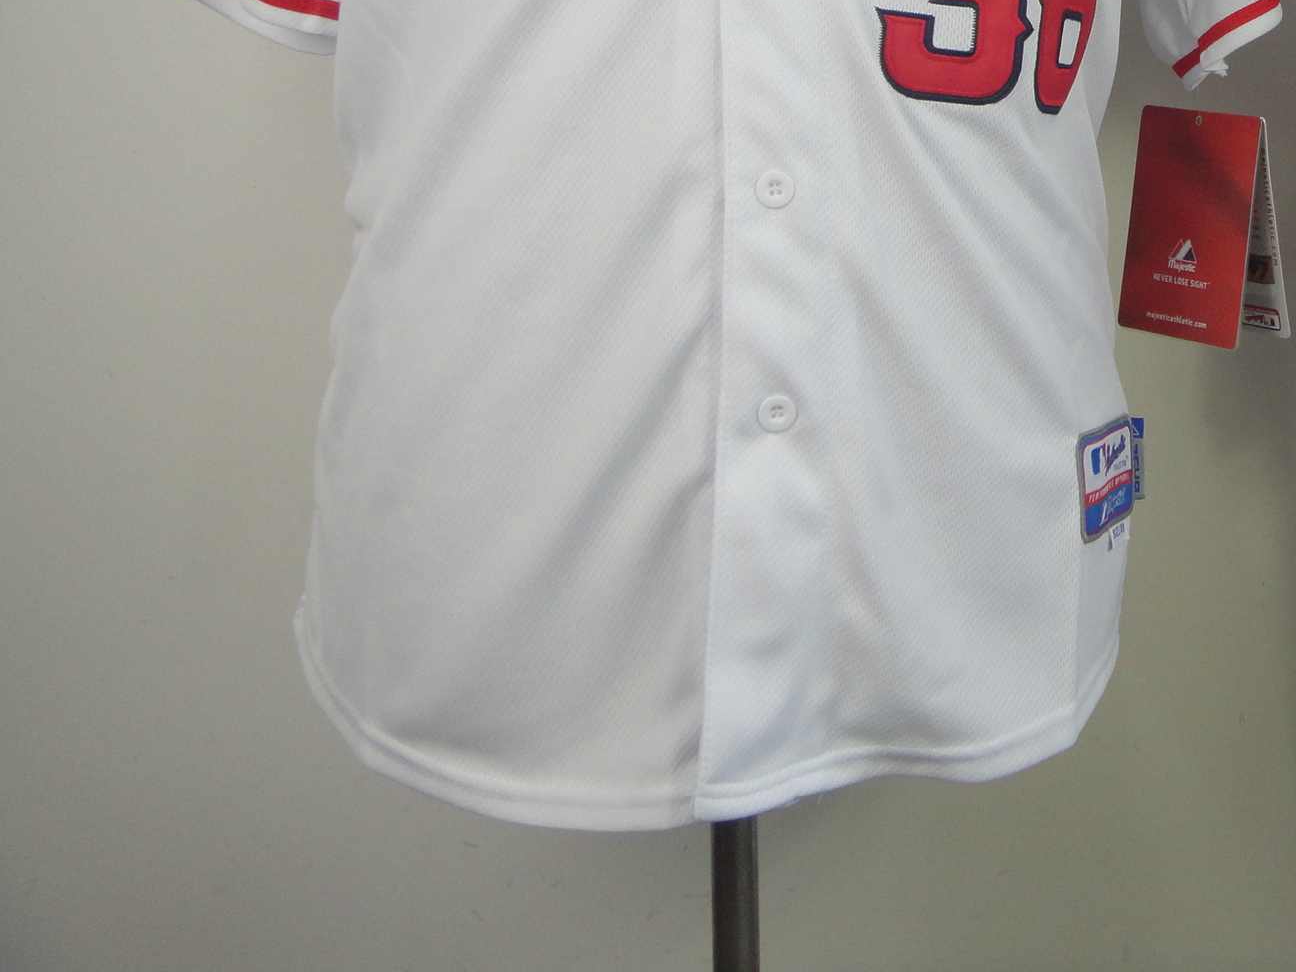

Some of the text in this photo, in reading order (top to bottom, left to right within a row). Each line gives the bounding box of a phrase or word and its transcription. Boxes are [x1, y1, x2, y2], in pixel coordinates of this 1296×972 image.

[1167, 259, 1196, 273] Majestic
[1153, 273, 1173, 284] NEVER
[1173, 276, 1189, 287] LOSE
[1145, 311, 1207, 329] majesticathletic.com
